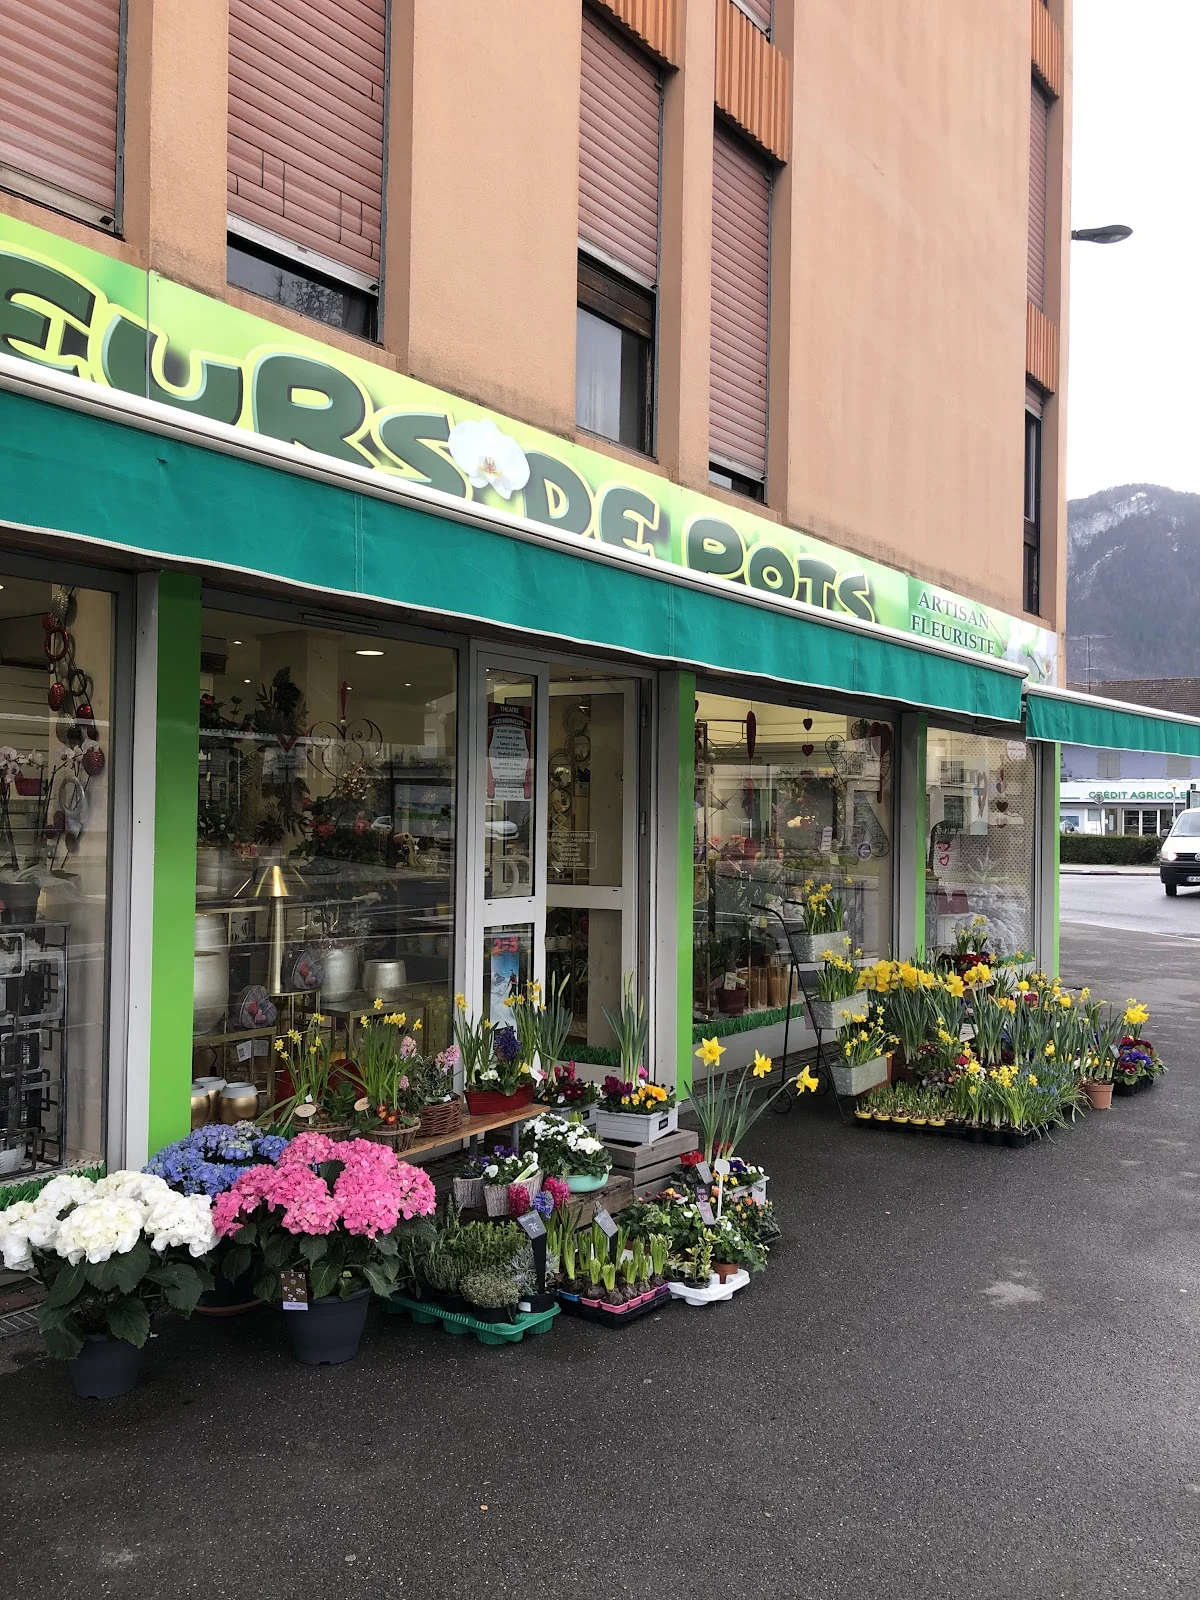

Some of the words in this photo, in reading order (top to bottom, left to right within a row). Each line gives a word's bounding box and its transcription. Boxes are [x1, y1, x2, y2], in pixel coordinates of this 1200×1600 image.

[522, 449, 661, 557] DE
[685, 516, 876, 622] POTS
[917, 591, 990, 629] ARTISAN
[910, 613, 996, 655] FLEURISTE
